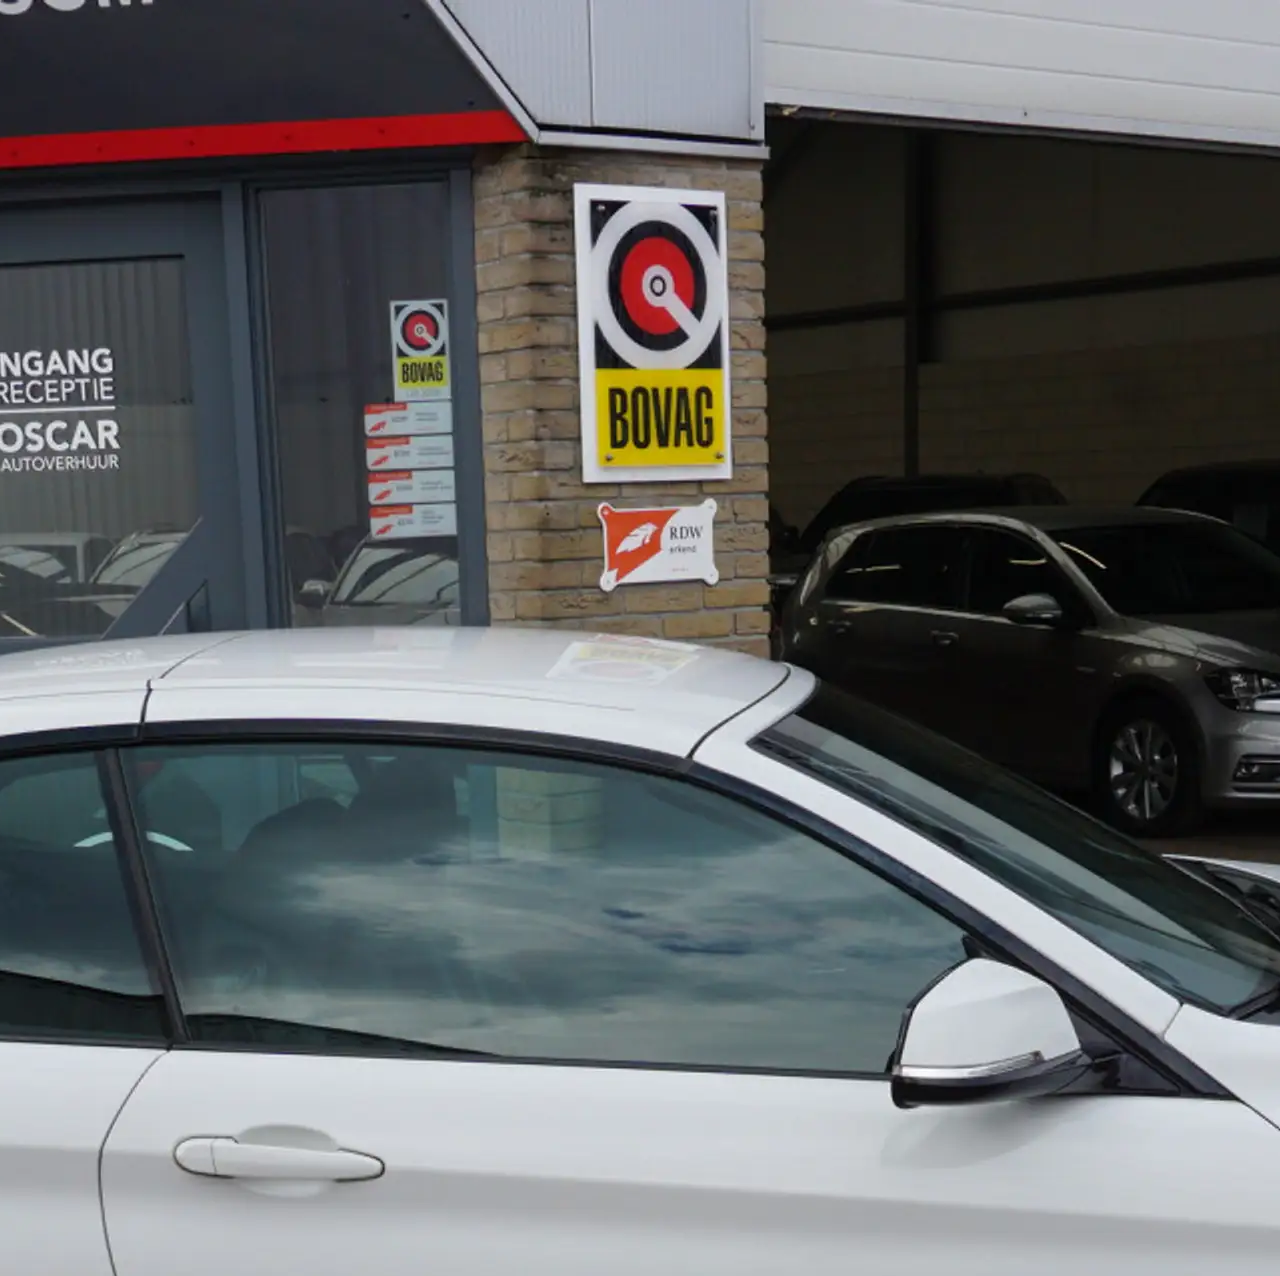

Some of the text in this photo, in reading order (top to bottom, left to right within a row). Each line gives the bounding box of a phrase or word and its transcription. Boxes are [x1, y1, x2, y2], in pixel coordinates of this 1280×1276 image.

[402, 361, 443, 383] BOVAG
[608, 386, 713, 449] BOVAG
[0, 454, 120, 472] AUTOVERHUUR
[669, 526, 703, 540] RDW
